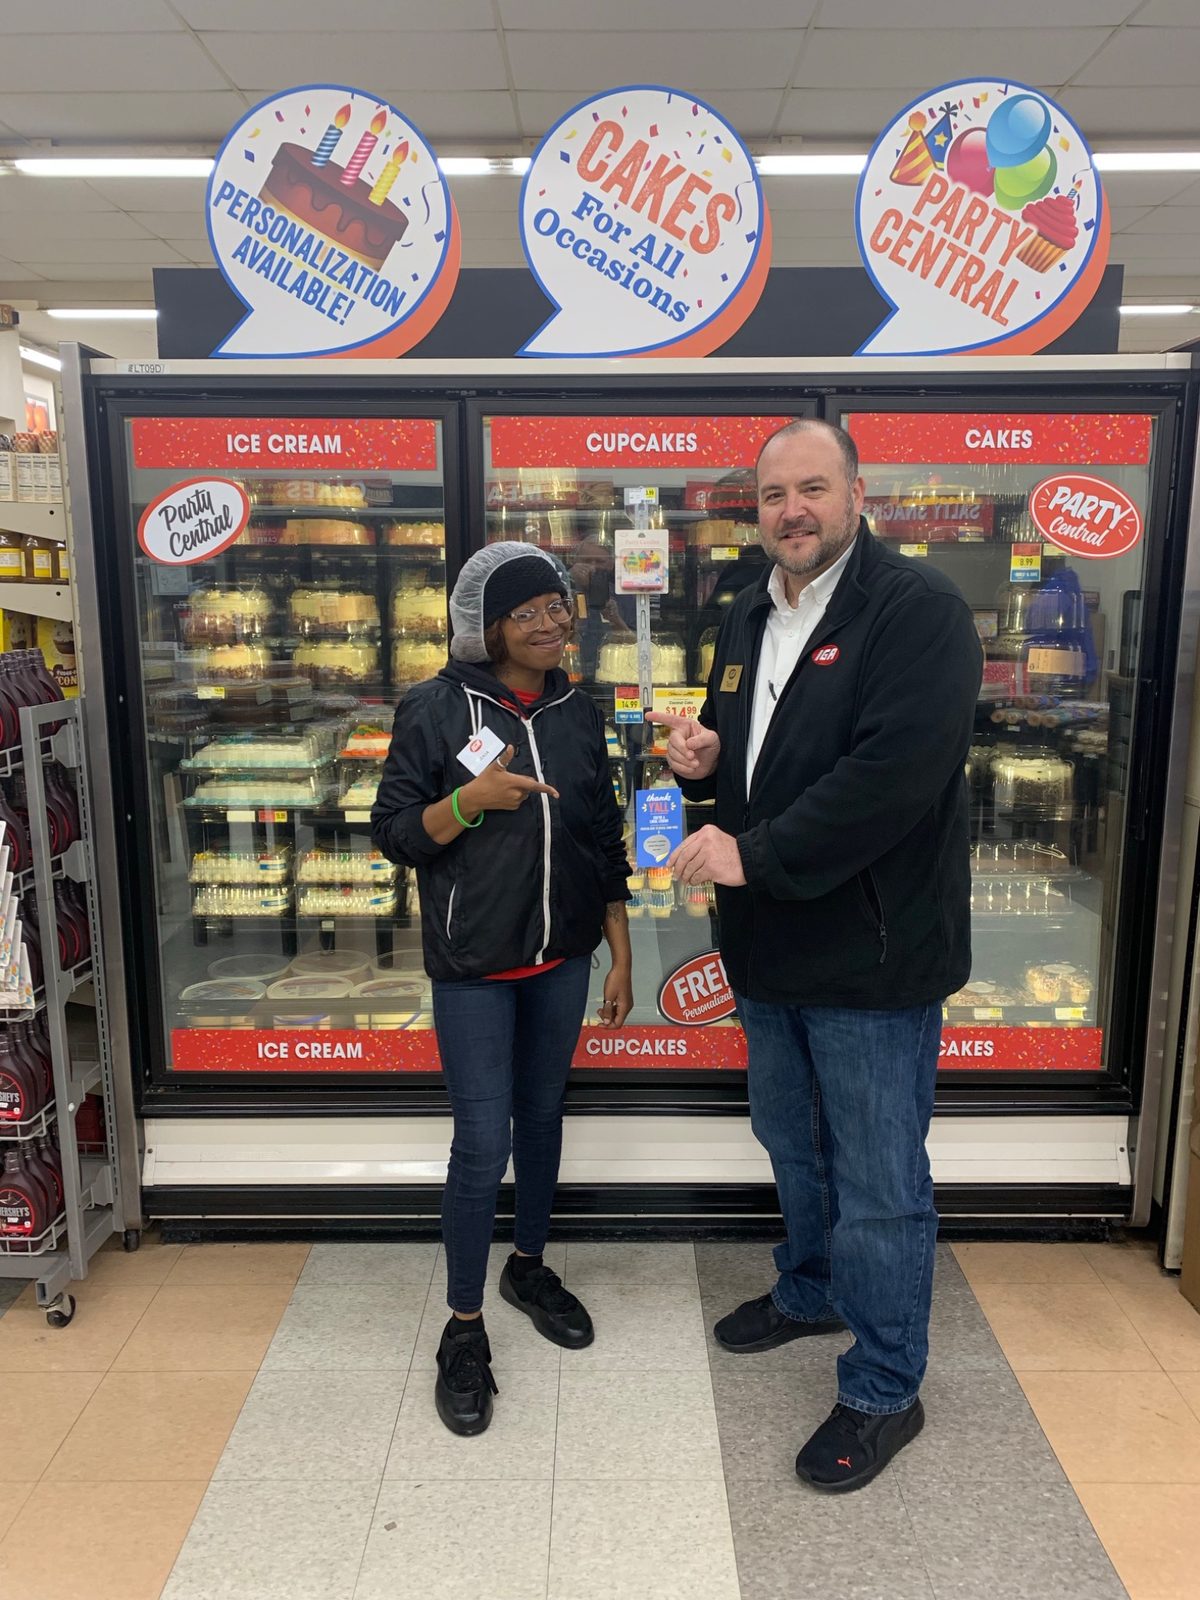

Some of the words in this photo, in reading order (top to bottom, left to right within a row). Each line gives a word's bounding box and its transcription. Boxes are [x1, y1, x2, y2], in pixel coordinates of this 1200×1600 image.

[576, 120, 737, 255] CAKES
[571, 191, 632, 245] For
[629, 232, 685, 279] All
[912, 172, 1033, 267] PARTY
[213, 180, 407, 318] PERSONALIZATION
[533, 207, 690, 323] Occasions
[869, 208, 1020, 327] CENTRAL
[231, 235, 356, 326] AVAILABLE!
[227, 433, 261, 454] ICE
[267, 433, 342, 454] CREAM
[586, 432, 698, 453] CUPCAKES
[965, 429, 1033, 449] CAKES
[158, 489, 215, 531] Party
[1048, 486, 1132, 530] PARTY
[169, 504, 233, 557] Central
[1049, 516, 1110, 547] Central
[815, 647, 839, 661] IGA
[646, 792, 672, 802] thanks
[682, 987, 734, 1021] Personalizat
[257, 1042, 289, 1059] ICE
[295, 1042, 363, 1059] CREAM
[586, 1038, 687, 1055] CUPCAKES
